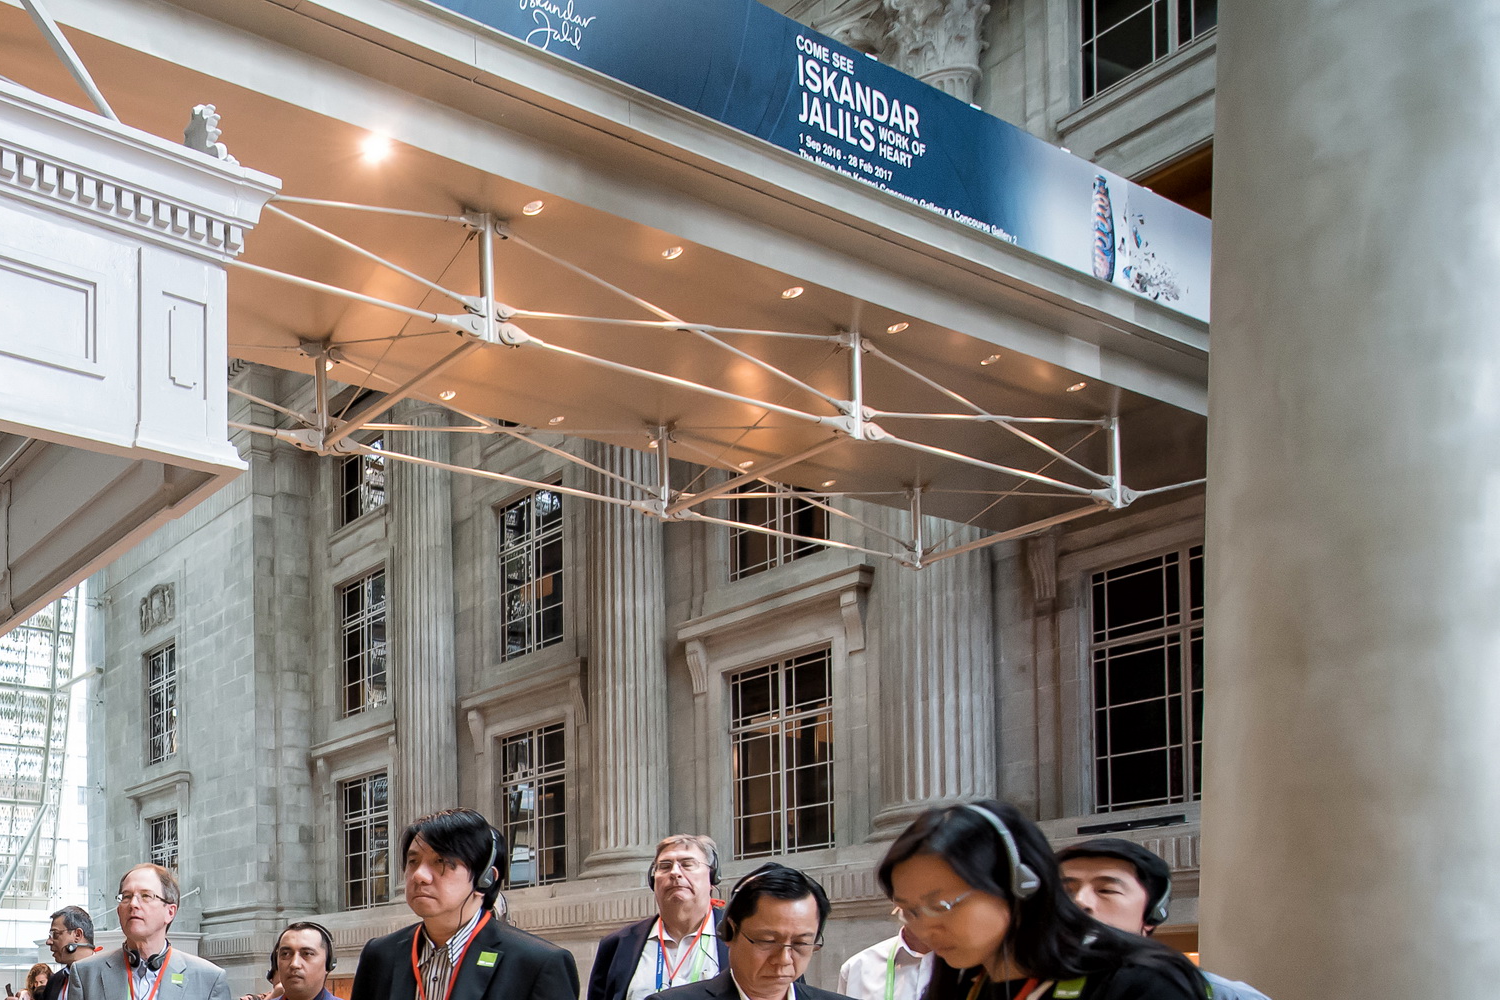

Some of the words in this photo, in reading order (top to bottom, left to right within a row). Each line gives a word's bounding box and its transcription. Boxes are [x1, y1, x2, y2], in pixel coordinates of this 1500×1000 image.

[796, 35, 830, 63] COME
[832, 52, 854, 75] SEE
[798, 54, 920, 138] ISKANDAR
[798, 91, 875, 152] JALIL'S
[878, 125, 909, 151] WORK
[911, 140, 926, 157] OF
[799, 133, 803, 144] 1
[805, 135, 821, 152] Sep
[822, 143, 842, 160] 2016
[847, 154, 858, 168] 28
[859, 158, 874, 174] Feb
[874, 165, 893, 182] 2017
[879, 142, 913, 168] HEART
